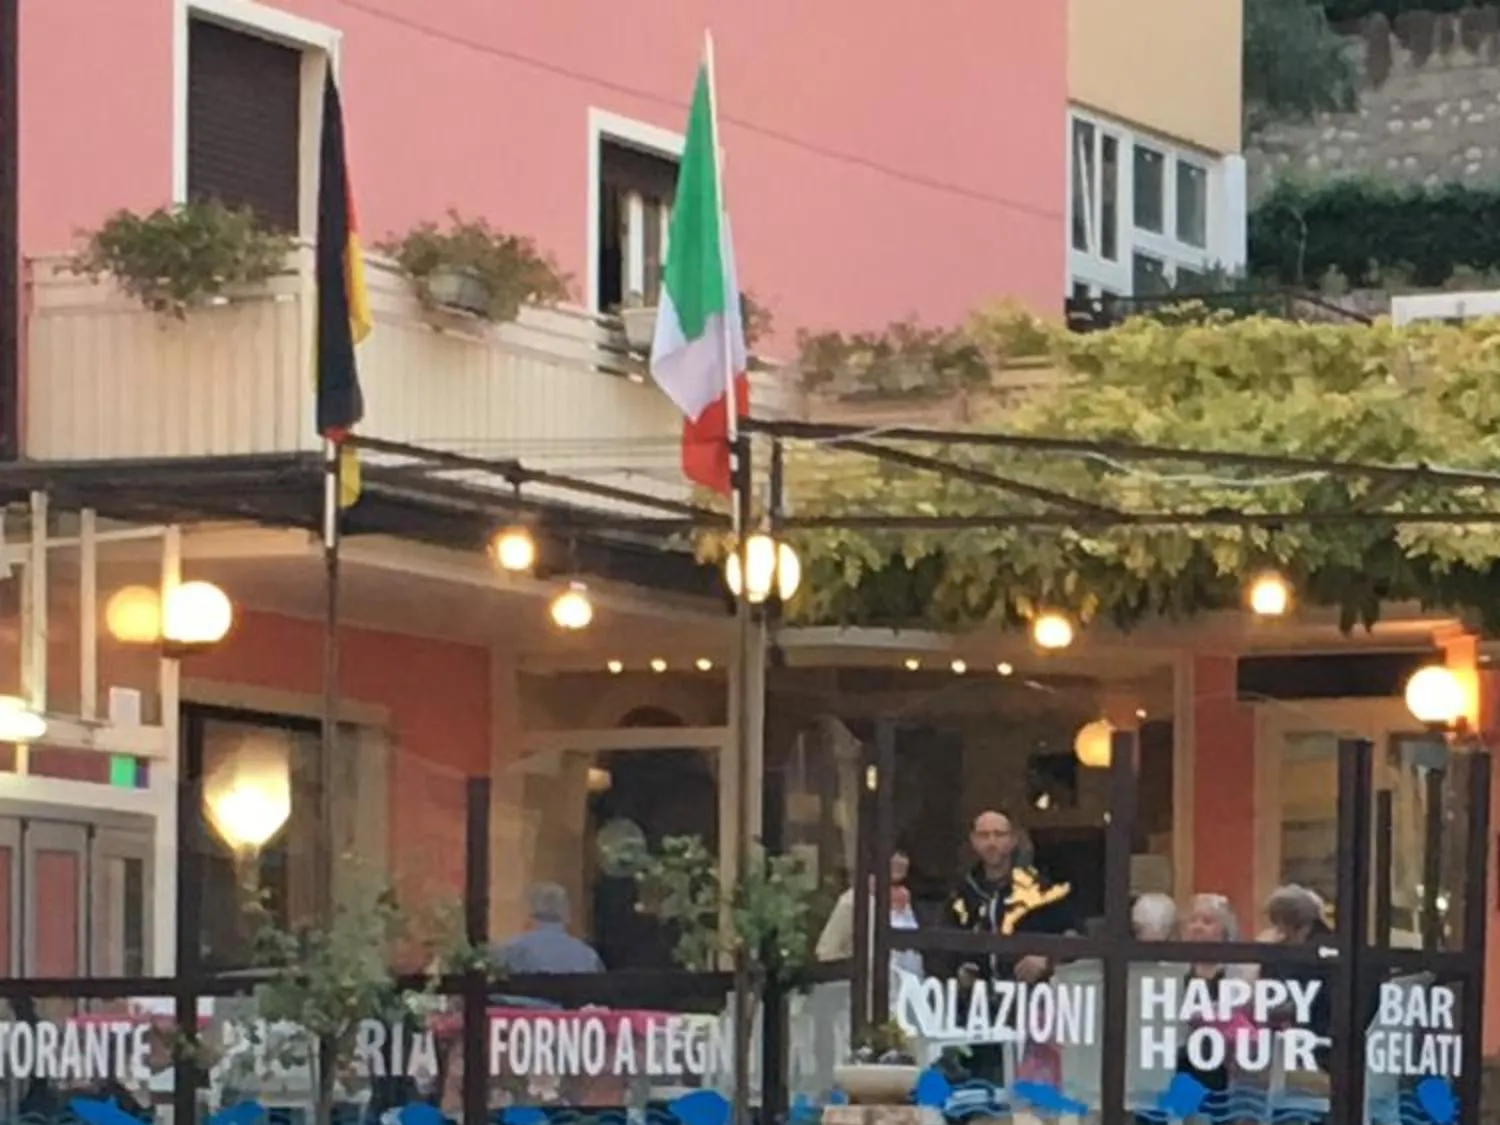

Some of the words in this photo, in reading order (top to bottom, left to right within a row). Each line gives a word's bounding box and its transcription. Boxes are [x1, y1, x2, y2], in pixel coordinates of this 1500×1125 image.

[897, 975, 1096, 1045] COLAZIONI
[1140, 976, 1322, 1023] HAPPY
[1379, 982, 1454, 1029] BAR
[488, 1017, 605, 1076] FORNO
[613, 1018, 638, 1075] A
[646, 1018, 738, 1076] LEGN
[1140, 1025, 1319, 1072] HOUR
[1366, 1031, 1462, 1077] GELATI
